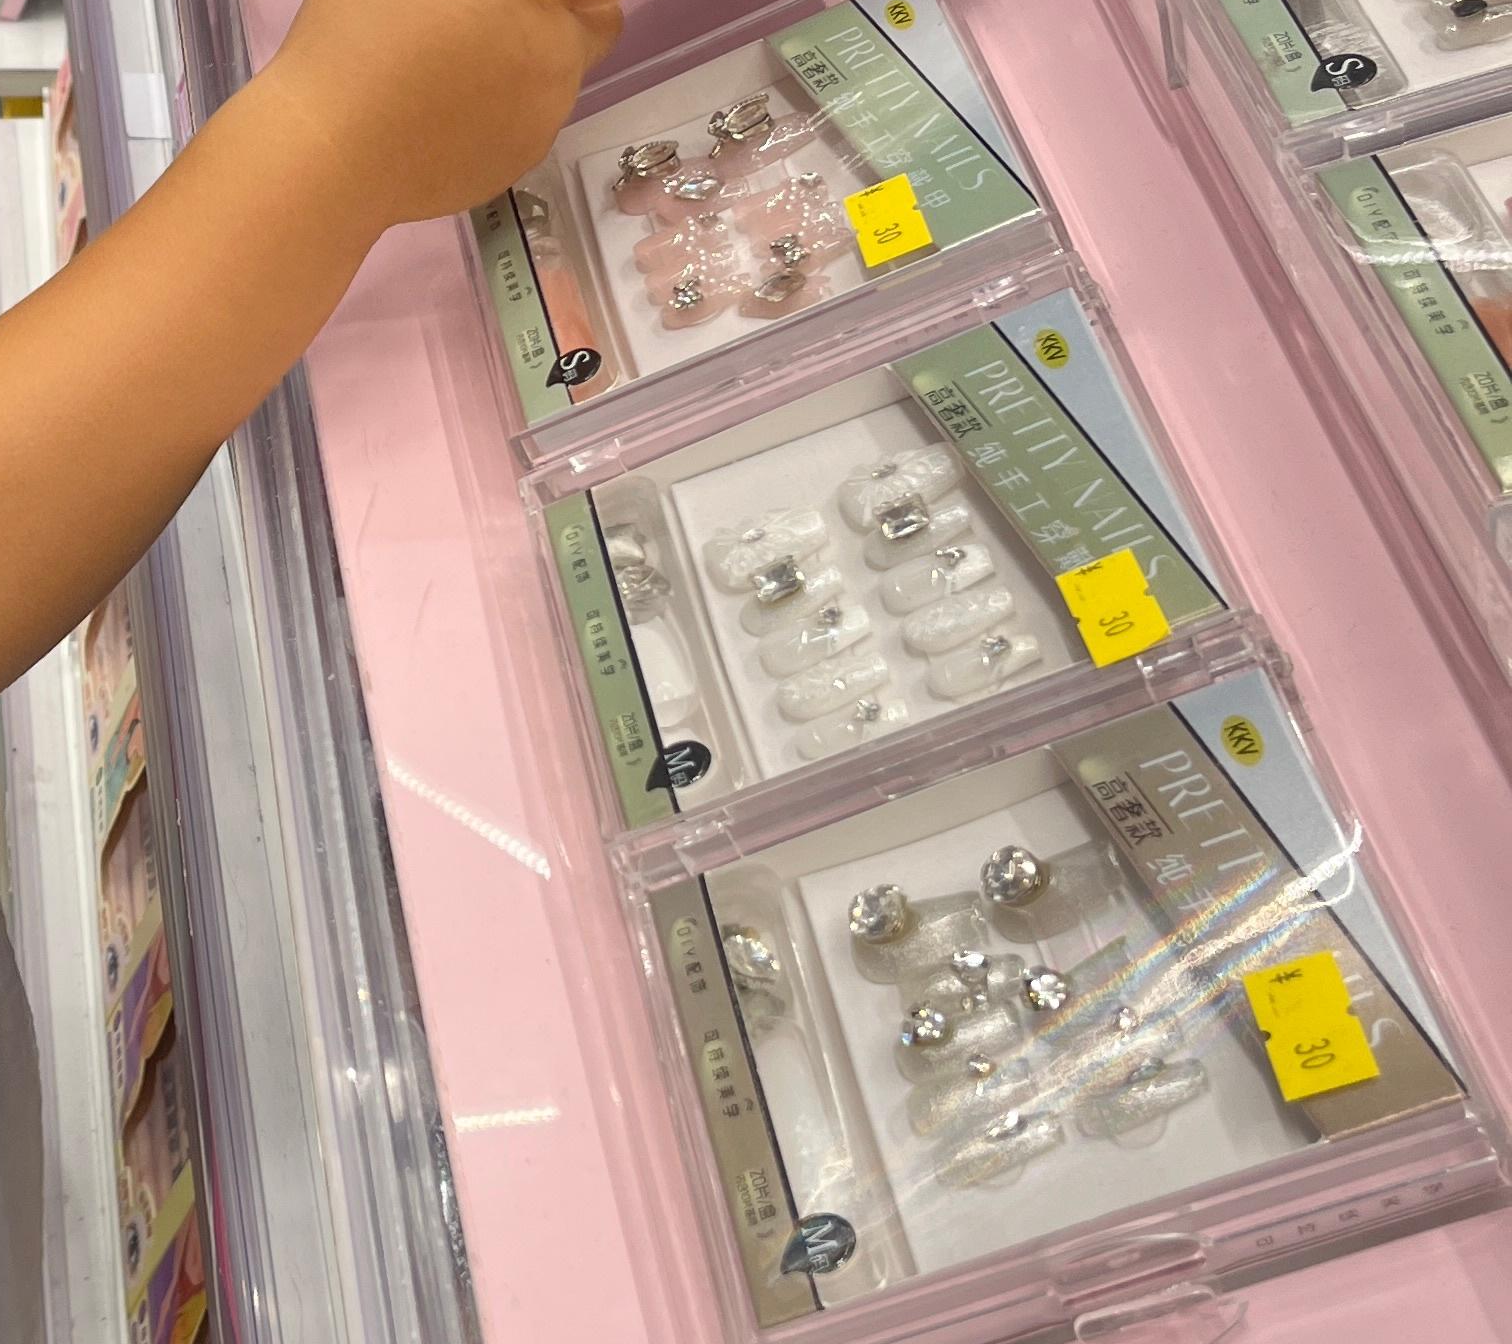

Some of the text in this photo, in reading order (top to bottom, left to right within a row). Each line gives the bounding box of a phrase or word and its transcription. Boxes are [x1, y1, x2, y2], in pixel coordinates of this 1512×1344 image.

[888, 2, 913, 25] KKV
[790, 51, 840, 91] 高奢款
[824, 26, 998, 190] PRETTY NAILS
[873, 223, 903, 244] 30
[1037, 332, 1067, 362] KKV
[924, 383, 982, 439] 高奢款
[963, 359, 1169, 580] PRETTY NAILS
[967, 441, 1094, 571] 纯手工穿戴
[1099, 611, 1135, 637] 30
[1225, 720, 1260, 757] KKV
[1091, 775, 1164, 847] 高奢款
[1140, 750, 1273, 878] PRETT
[675, 924, 707, 994] DIY配饰
[703, 1029, 741, 1118] 可持续美学
[1294, 1037, 1337, 1070] 30
[748, 1167, 777, 1222] 20片/盒
[801, 1219, 840, 1275] M码
